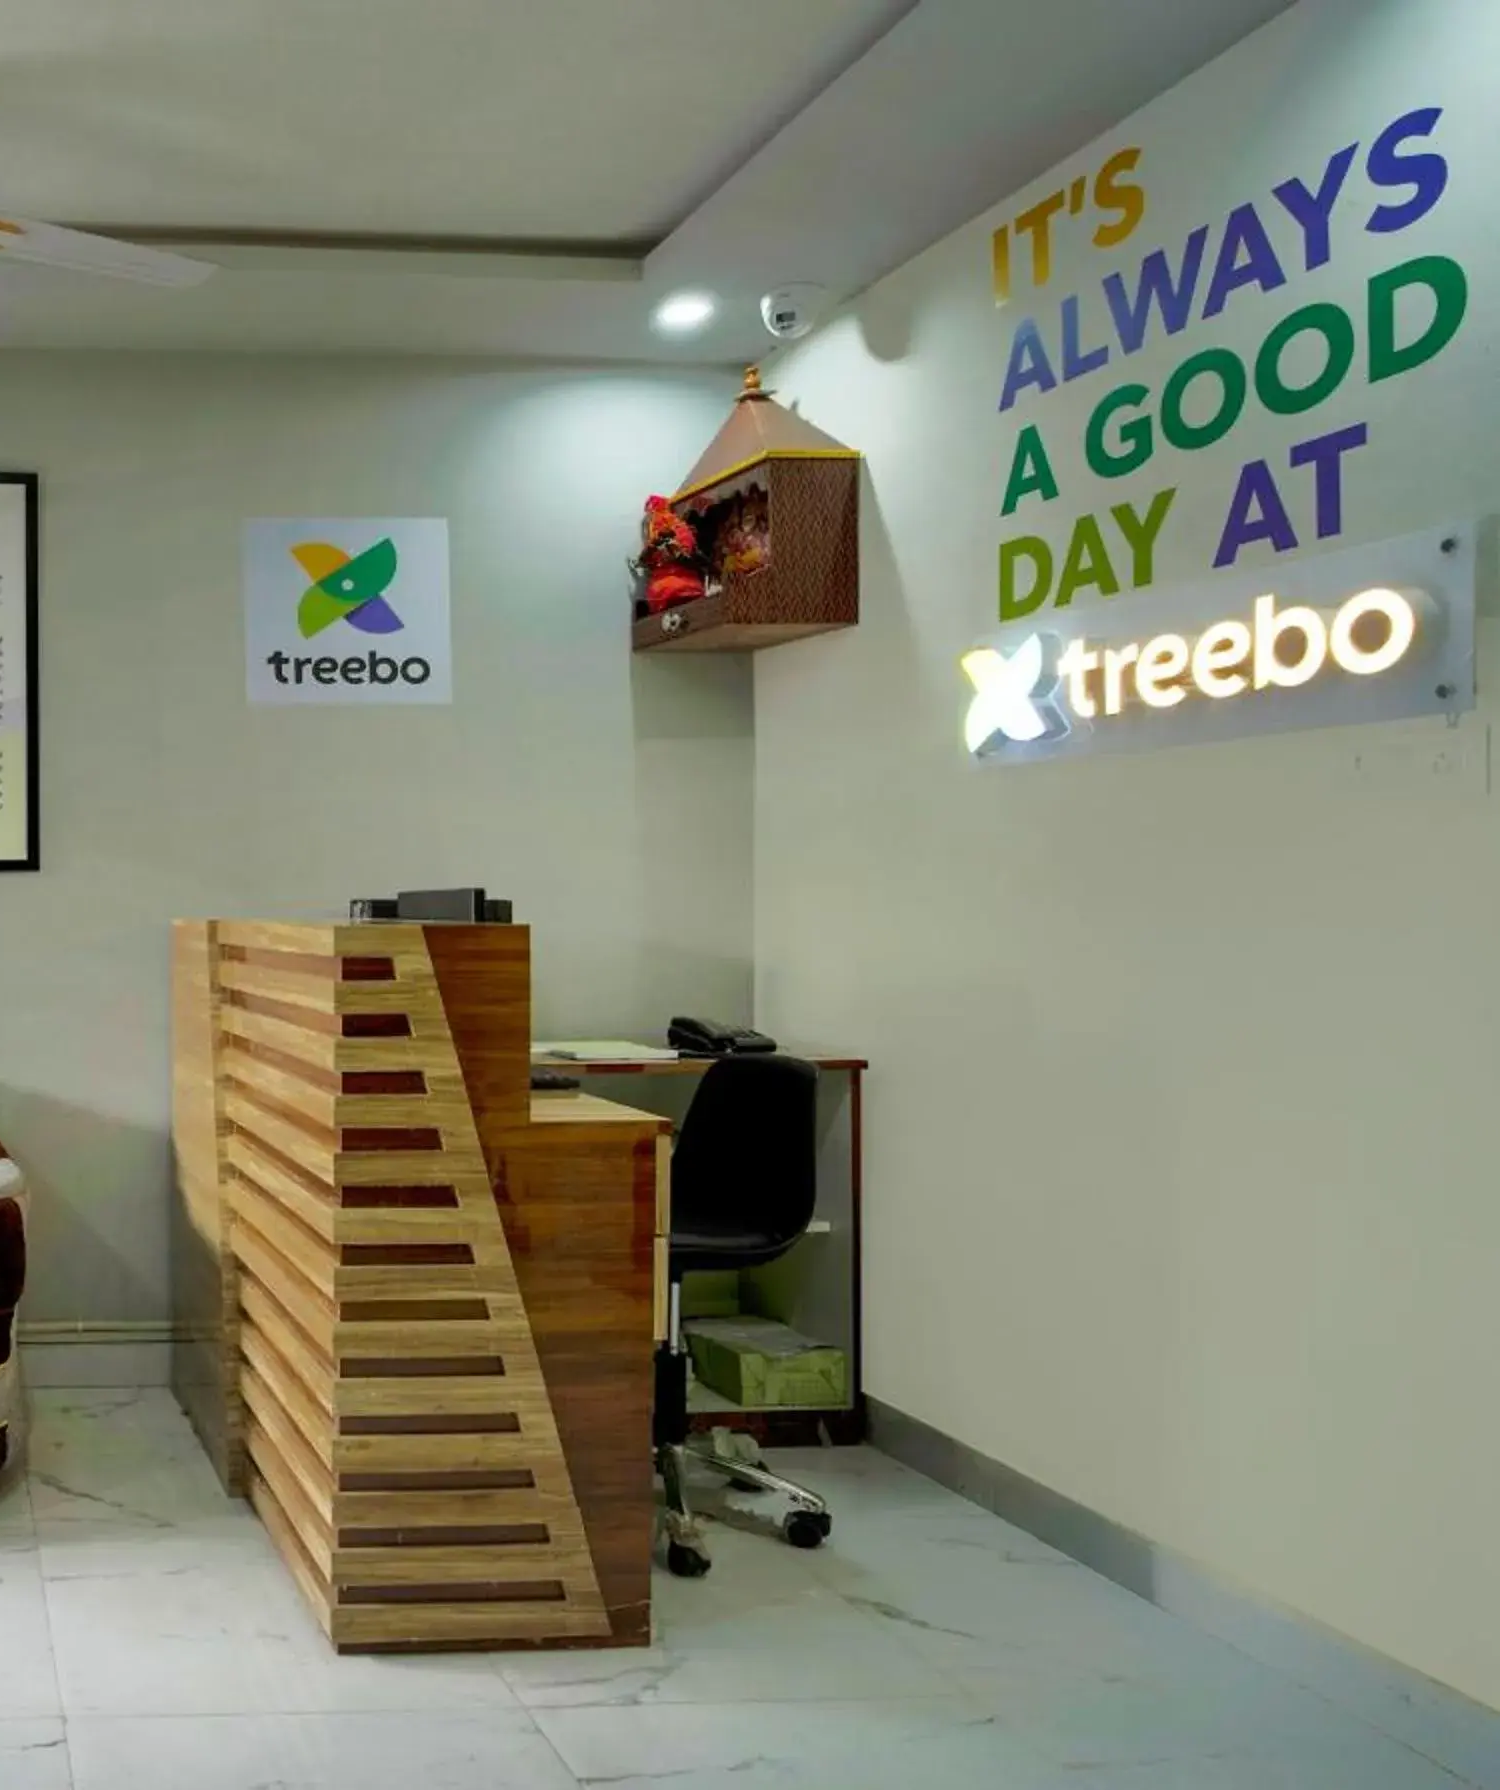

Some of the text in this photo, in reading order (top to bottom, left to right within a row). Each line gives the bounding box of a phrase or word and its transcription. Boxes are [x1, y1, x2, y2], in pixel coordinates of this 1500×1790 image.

[992, 147, 1144, 307] IT'S
[998, 107, 1448, 412] ALWAYS
[1001, 255, 1467, 517] A GOOD
[998, 422, 1367, 622] DAY AT
[267, 651, 430, 685] treebo
[1057, 588, 1414, 719] treebo
